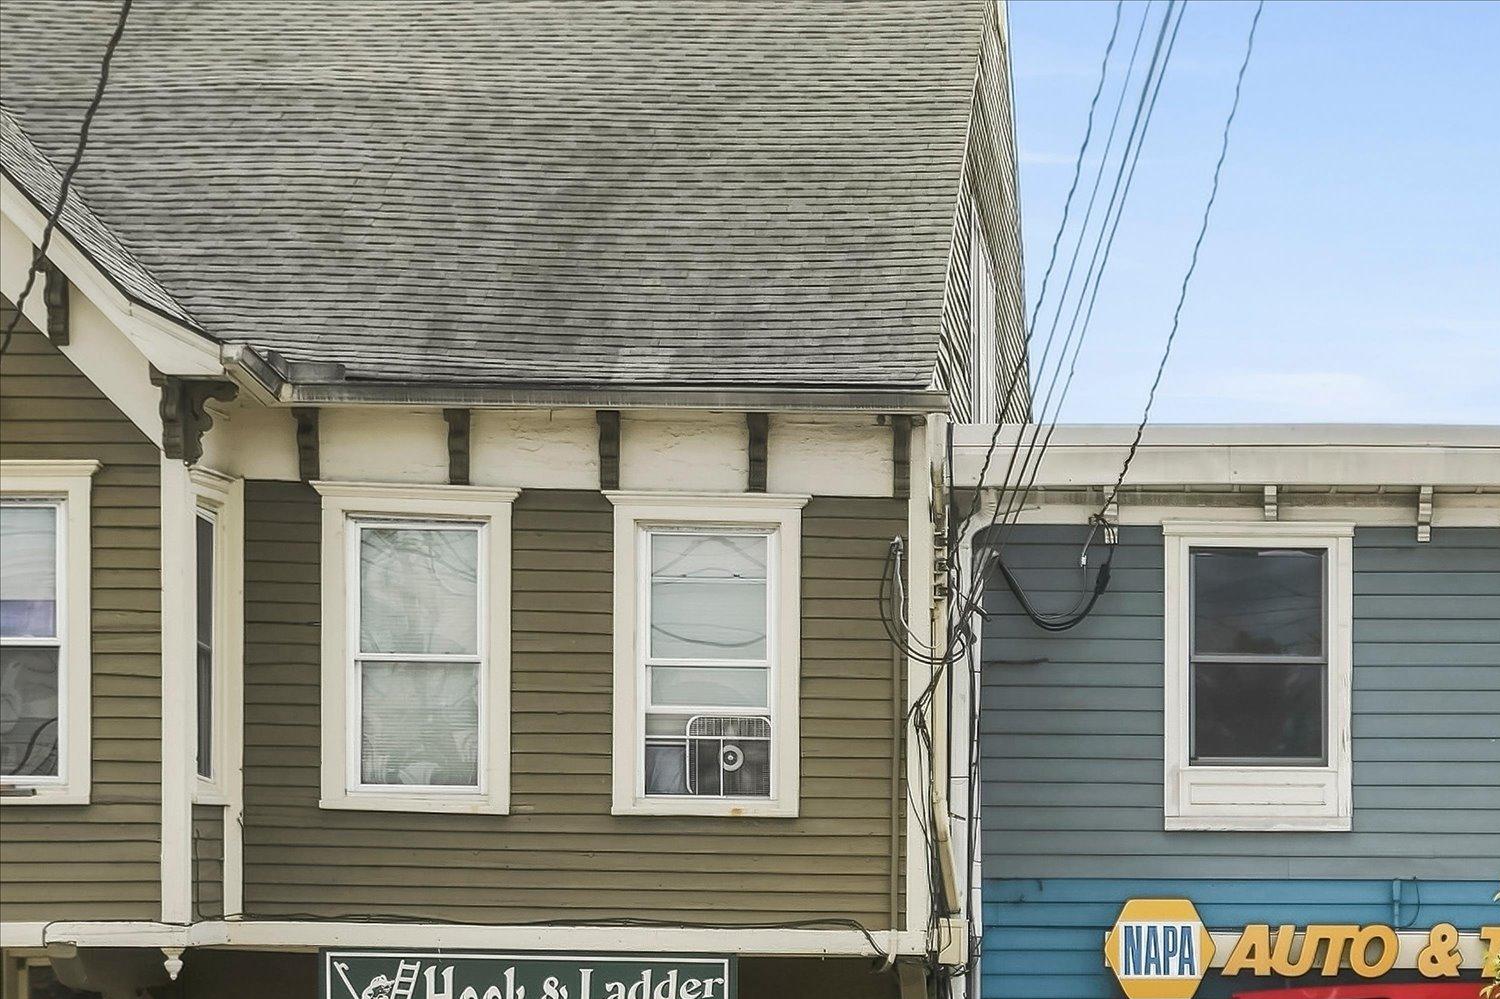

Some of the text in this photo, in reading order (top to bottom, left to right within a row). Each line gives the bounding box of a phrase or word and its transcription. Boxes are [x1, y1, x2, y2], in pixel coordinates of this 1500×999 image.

[1124, 925, 1196, 976] NAPA
[1221, 924, 1401, 979] AUTO
[1417, 922, 1464, 979] &
